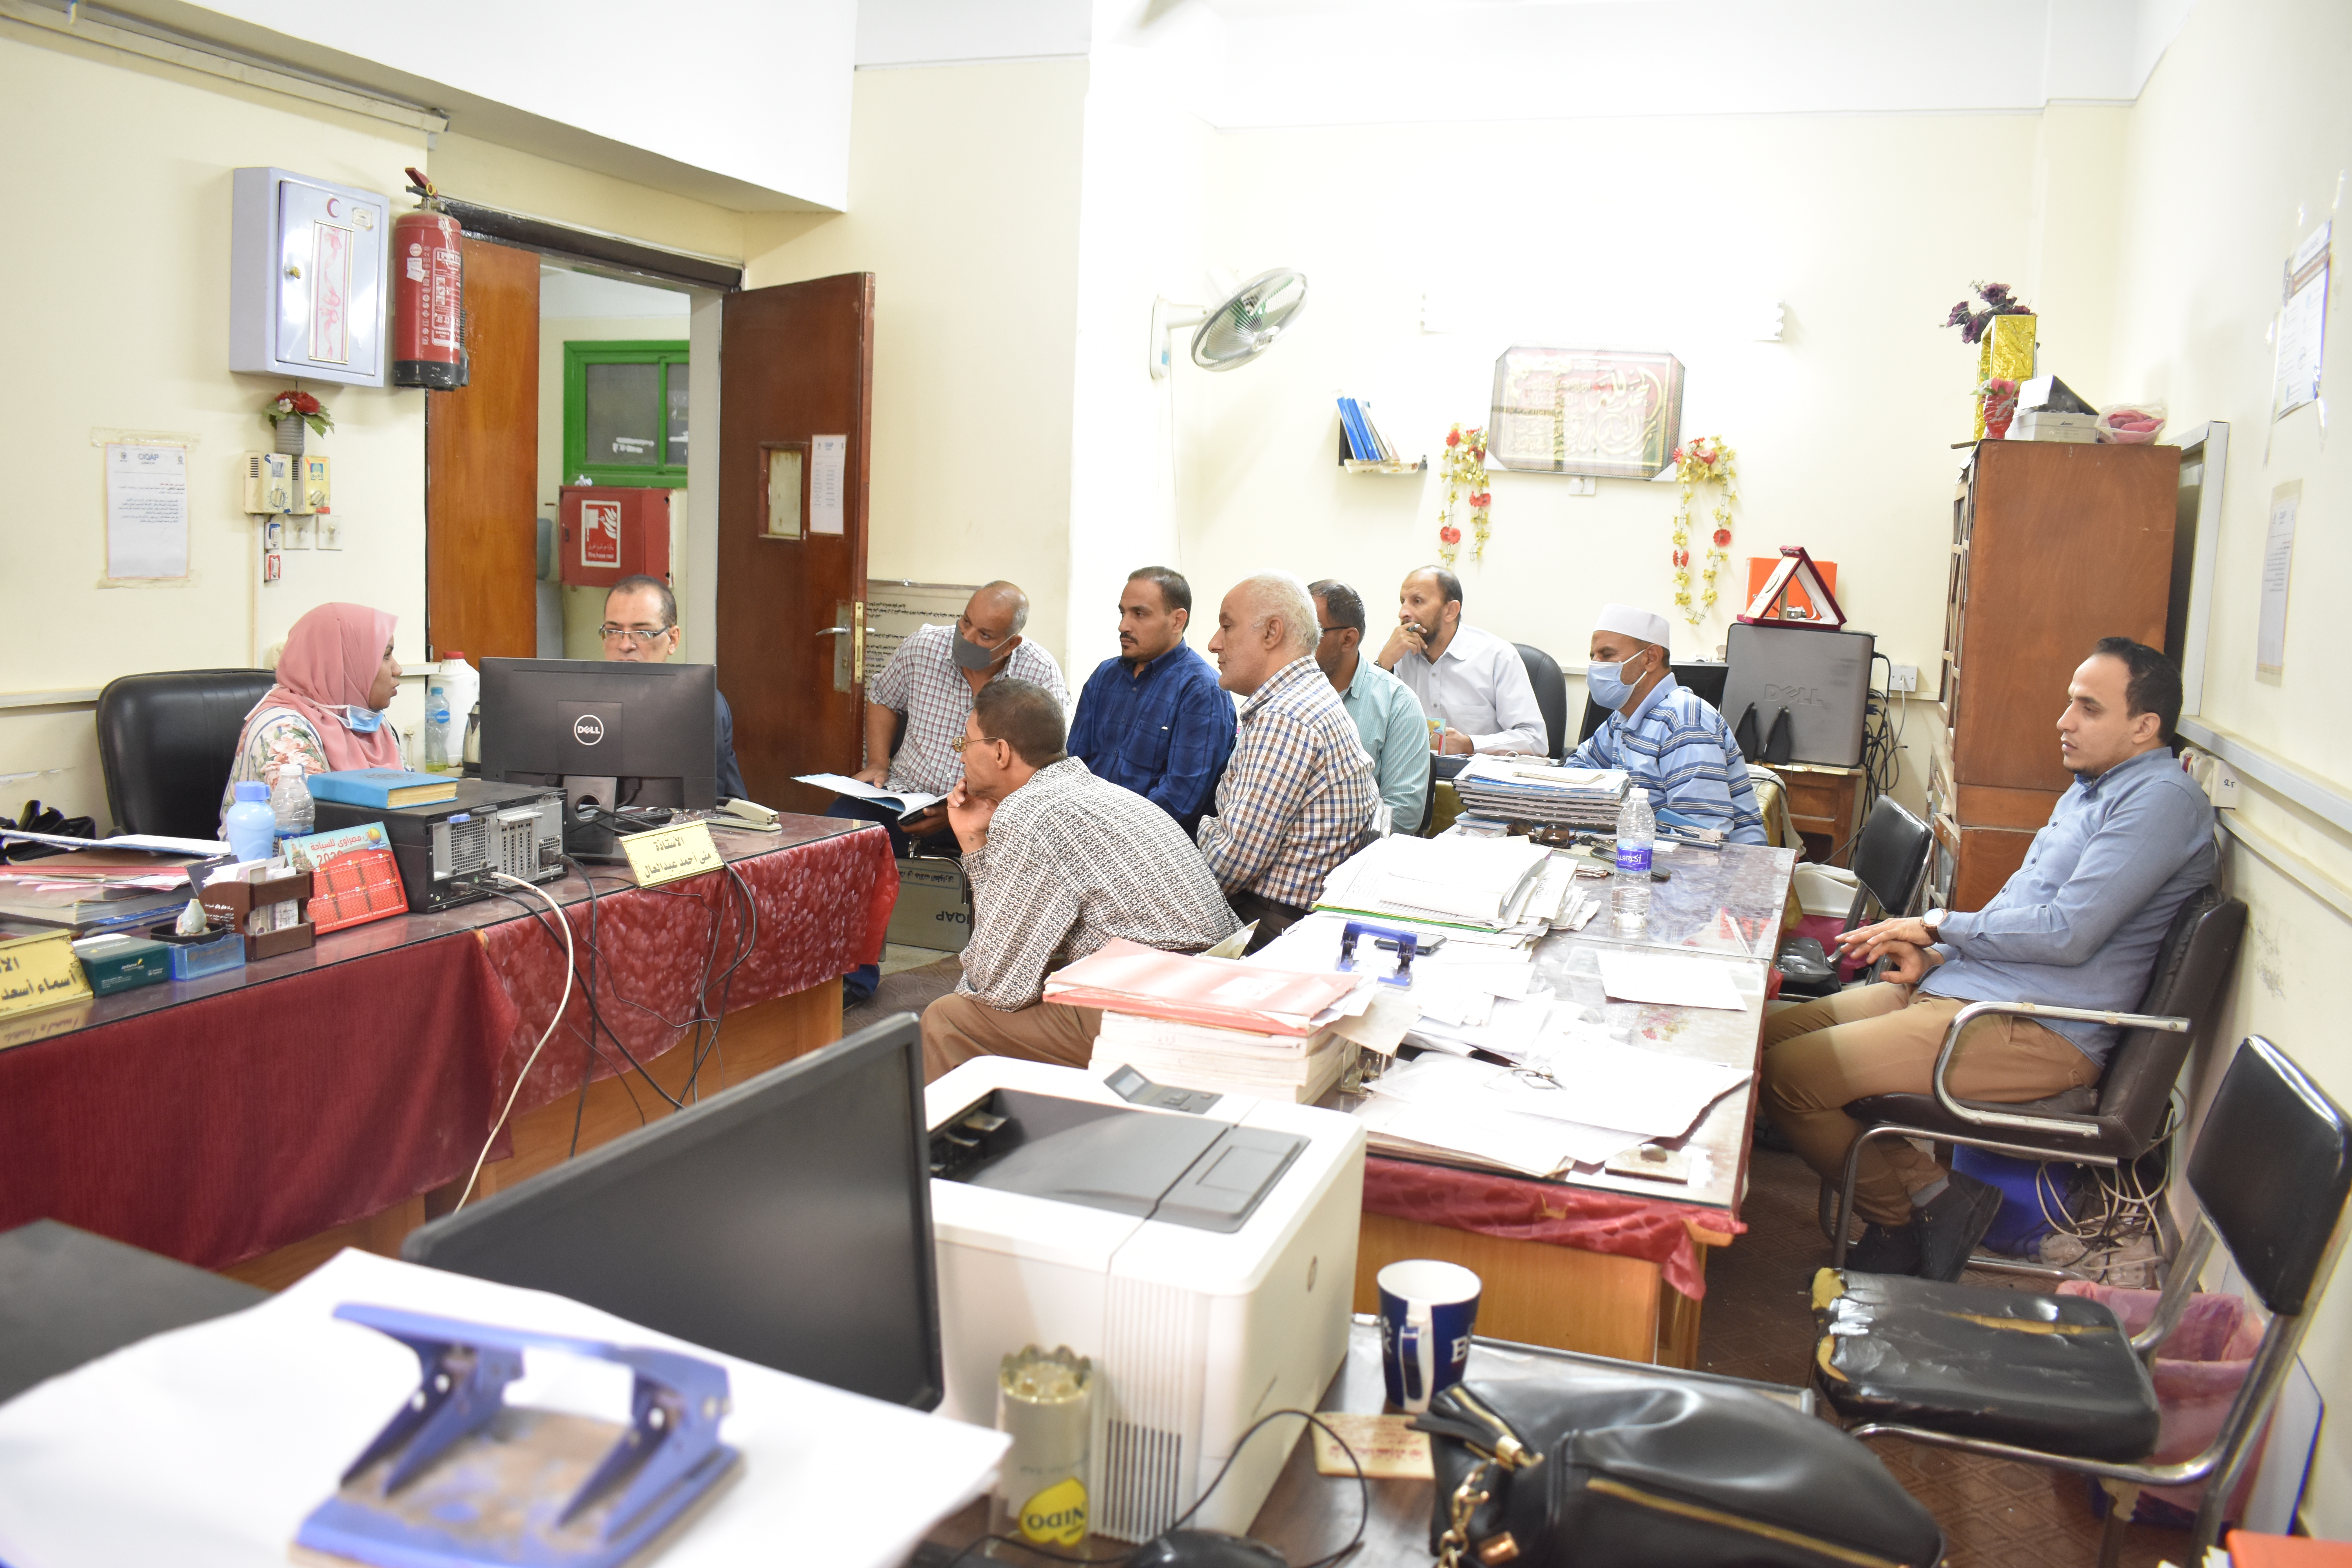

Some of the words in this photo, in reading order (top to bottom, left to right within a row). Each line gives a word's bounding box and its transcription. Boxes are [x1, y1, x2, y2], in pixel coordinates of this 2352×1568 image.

[1764, 684, 1823, 706] DELL
[577, 726, 601, 734] DELL
[310, 838, 335, 851] للسياحة
[653, 835, 685, 851] الأستاذة
[680, 851, 697, 867] أحمد
[699, 851, 711, 864] منى
[935, 911, 970, 924] IQAP
[0, 978, 34, 1000] أسعد
[38, 969, 77, 995] أسماء
[1027, 1508, 1084, 1531] NIDO
